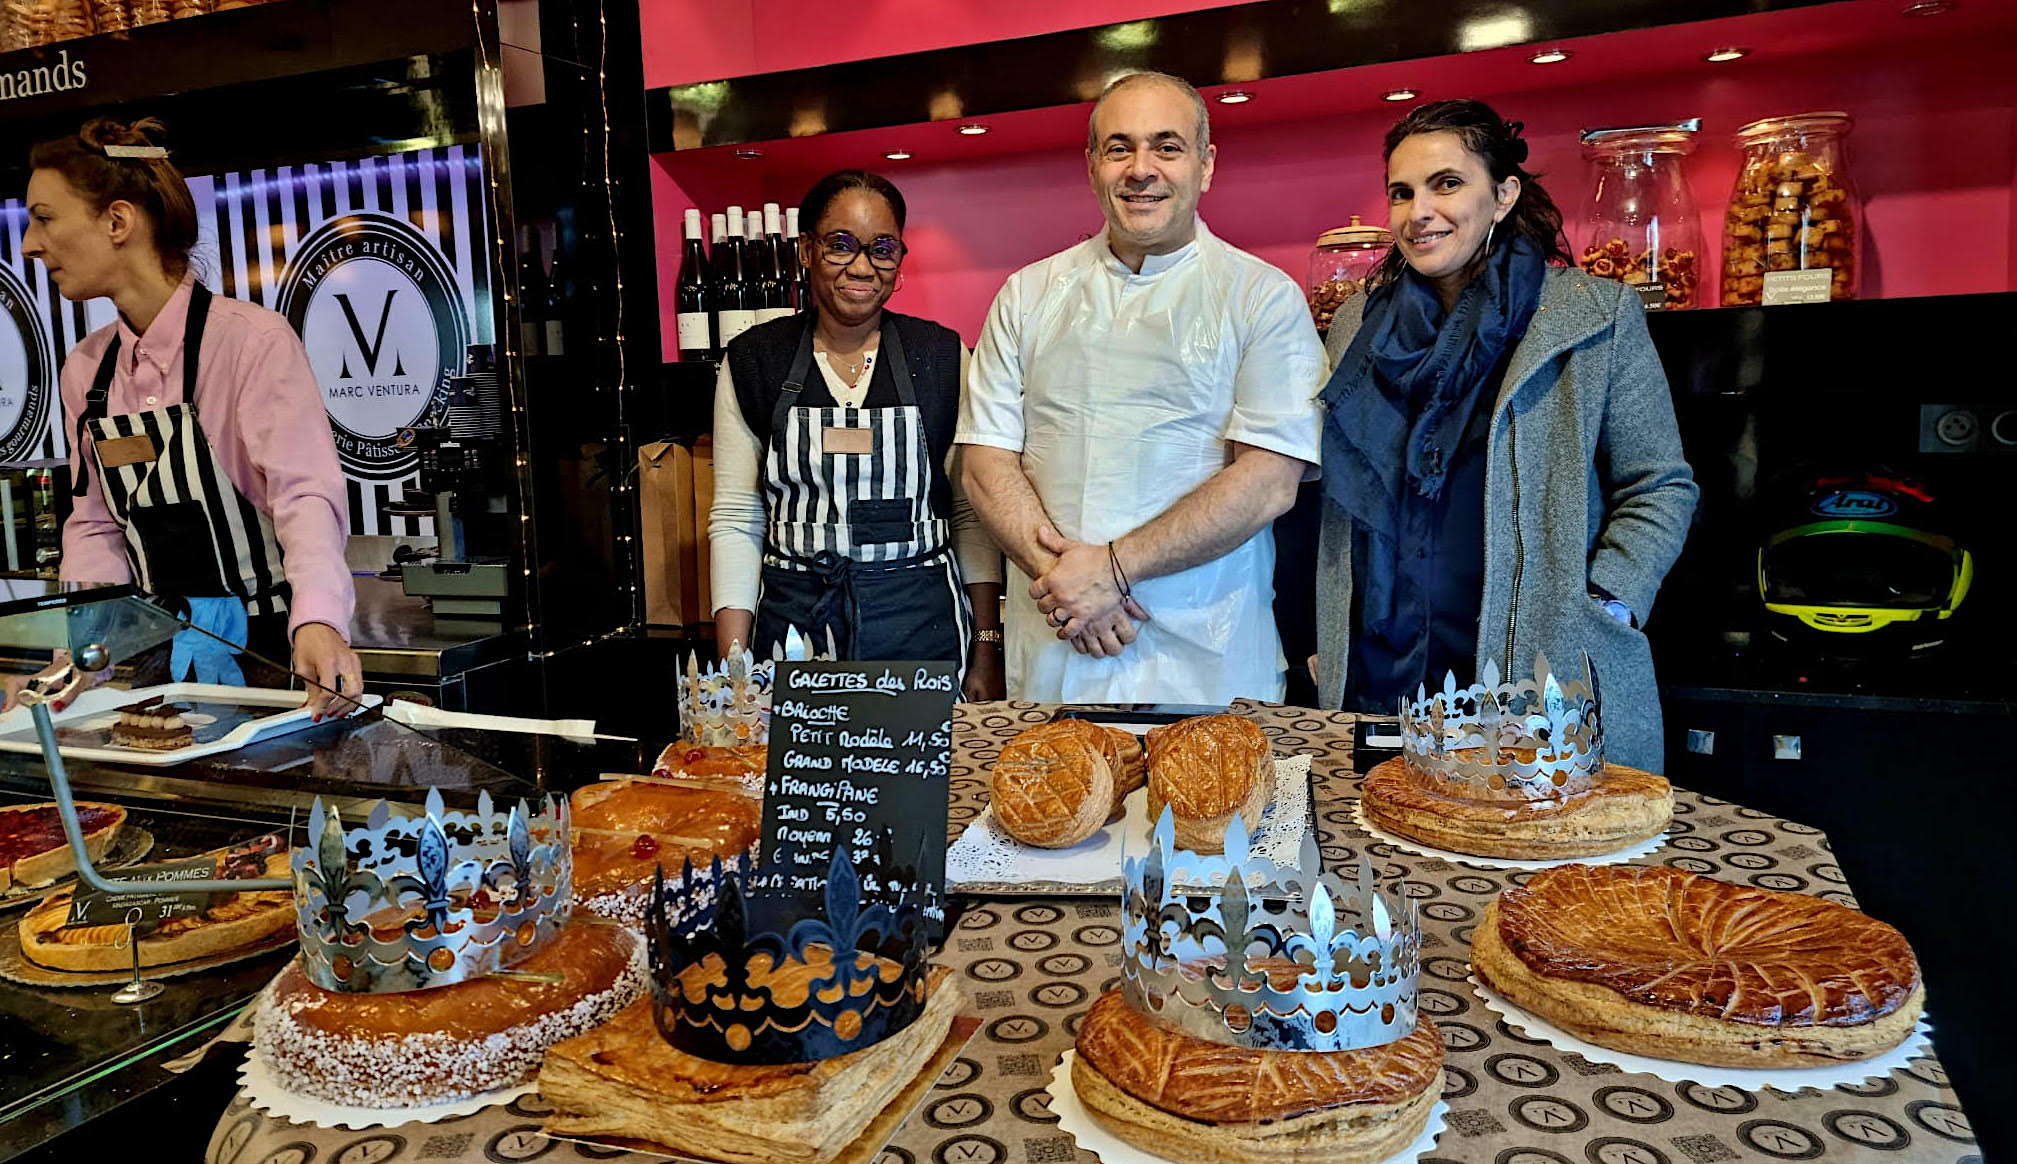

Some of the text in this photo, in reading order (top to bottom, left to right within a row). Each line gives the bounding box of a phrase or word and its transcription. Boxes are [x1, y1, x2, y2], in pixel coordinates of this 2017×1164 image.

[301, 241, 424, 291] Maître artisan
[329, 384, 420, 398] MARC VENTURA
[7, 383, 40, 455] gourmands
[1822, 494, 1884, 510] Arai
[788, 669, 869, 690] GALETTES
[875, 668, 907, 692] des
[783, 750, 833, 771] GRAND
[155, 866, 210, 882] POMMES
